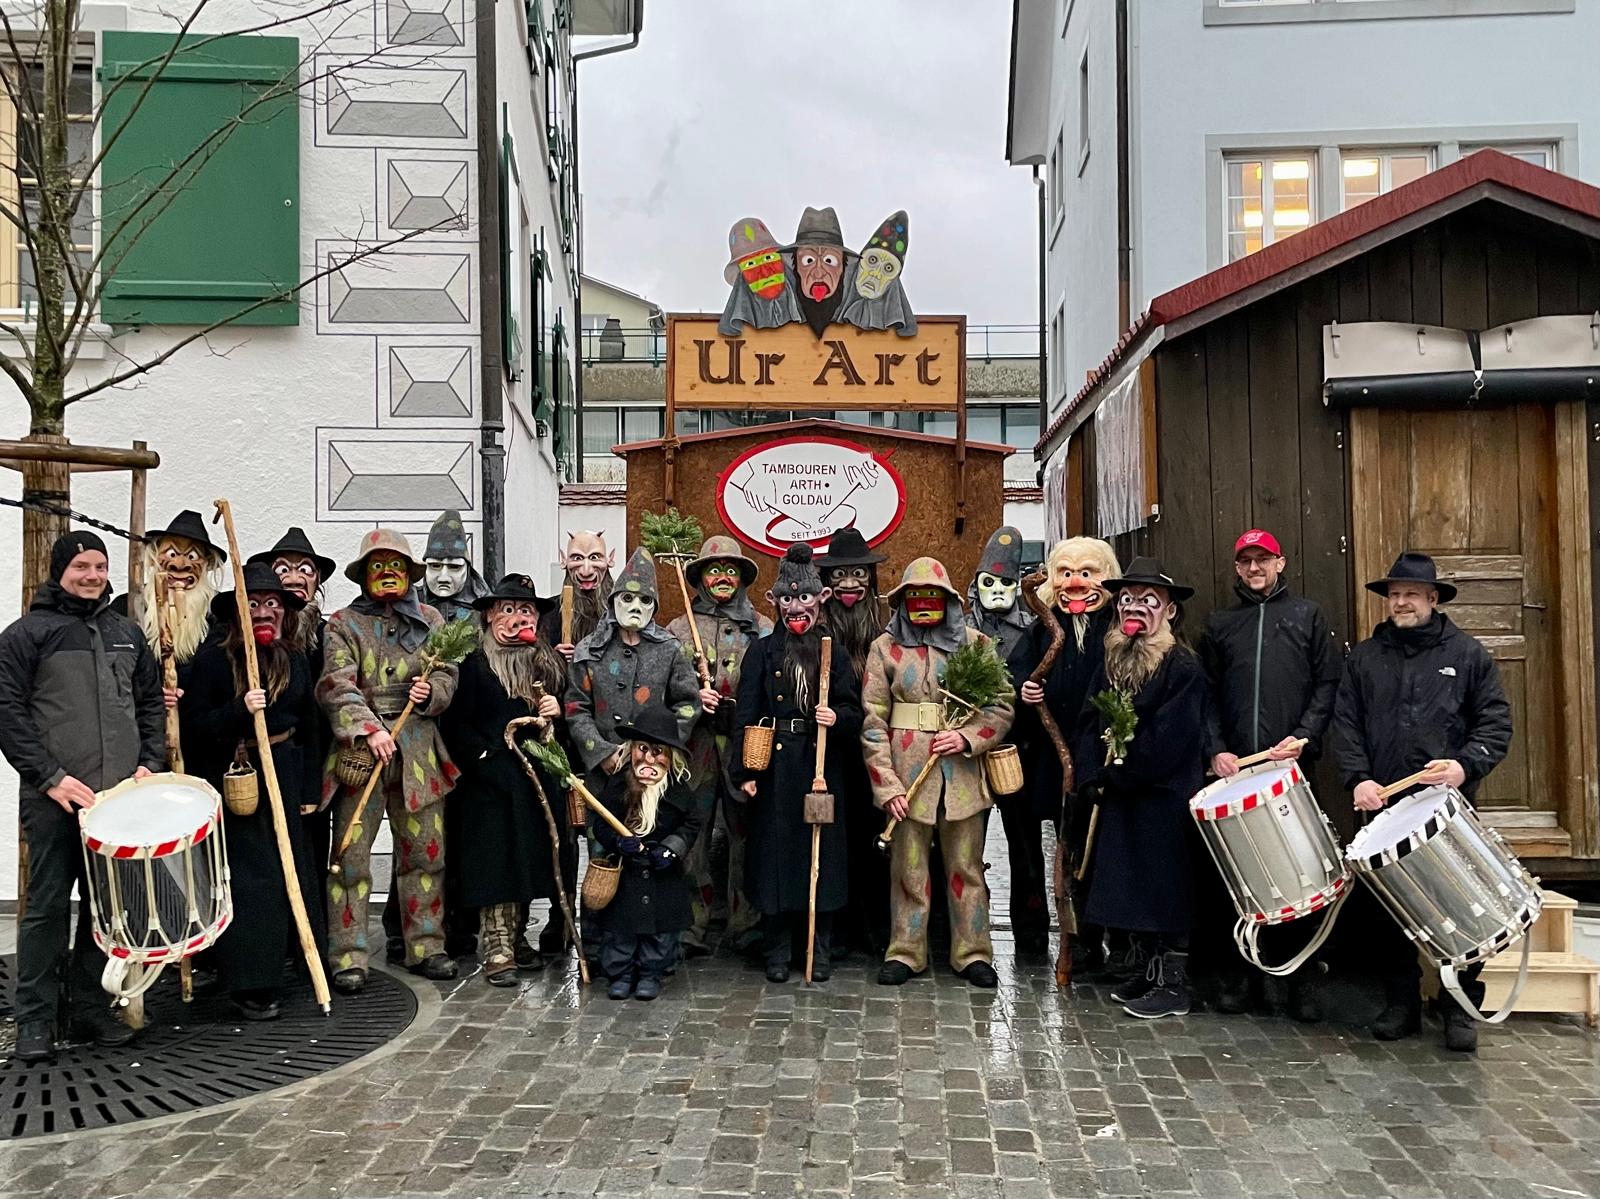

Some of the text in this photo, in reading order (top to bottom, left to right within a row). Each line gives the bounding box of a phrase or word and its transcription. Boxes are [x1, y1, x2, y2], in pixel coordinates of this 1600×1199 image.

[693, 339, 942, 385] Ur Art
[762, 463, 837, 475] TAMBOUREN
[782, 494, 832, 506] GOLDAU
[791, 526, 832, 540] SEIT 1993
